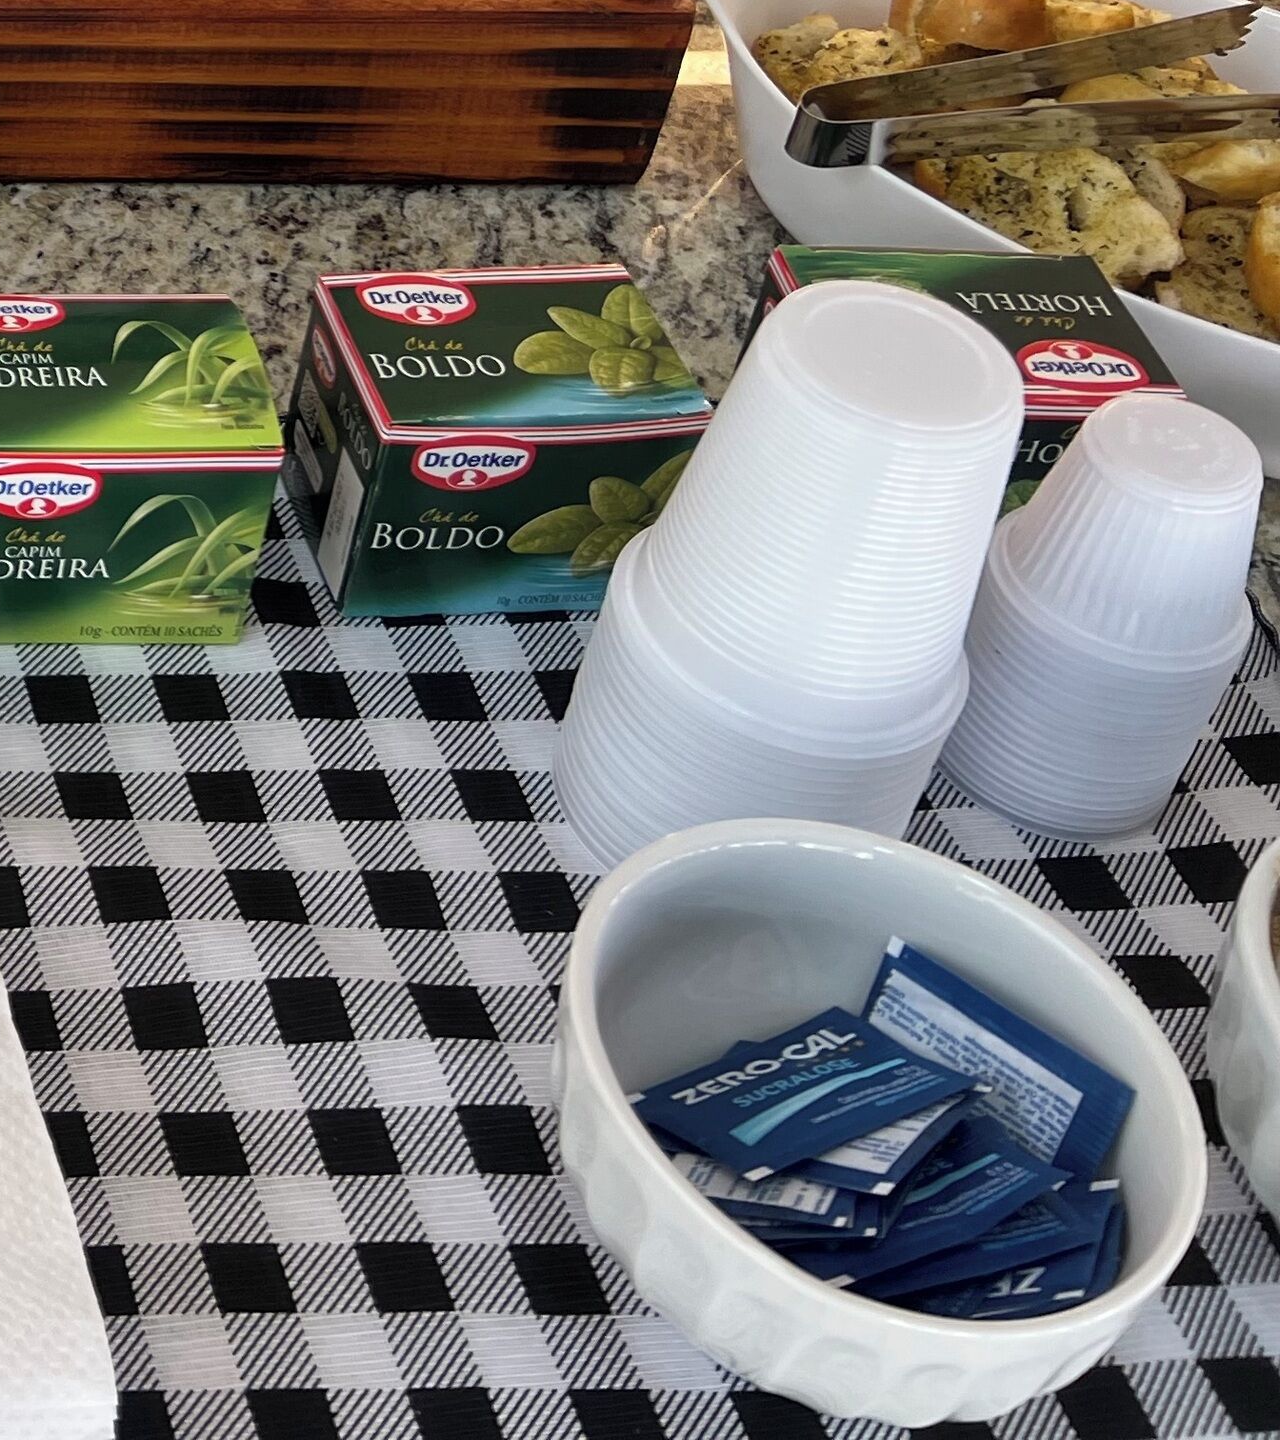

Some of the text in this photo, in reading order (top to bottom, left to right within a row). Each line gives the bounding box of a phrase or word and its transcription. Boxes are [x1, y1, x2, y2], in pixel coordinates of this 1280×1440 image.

[954, 291, 1114, 317] HORTELÃ
[33, 340, 54, 352] de
[404, 336, 465, 351] Chá de
[0, 353, 54, 364] CAPIM
[368, 353, 507, 379] BOLDO
[458, 510, 480, 523] de
[44, 529, 67, 544] de
[369, 522, 505, 550] BOLDO
[4, 545, 62, 559] CAPIM
[79, 626, 102, 639] 10g
[111, 624, 161, 637] CONTÉM
[177, 624, 223, 637] SACHÊS
[731, 1058, 863, 1108] SUCRALOSE
